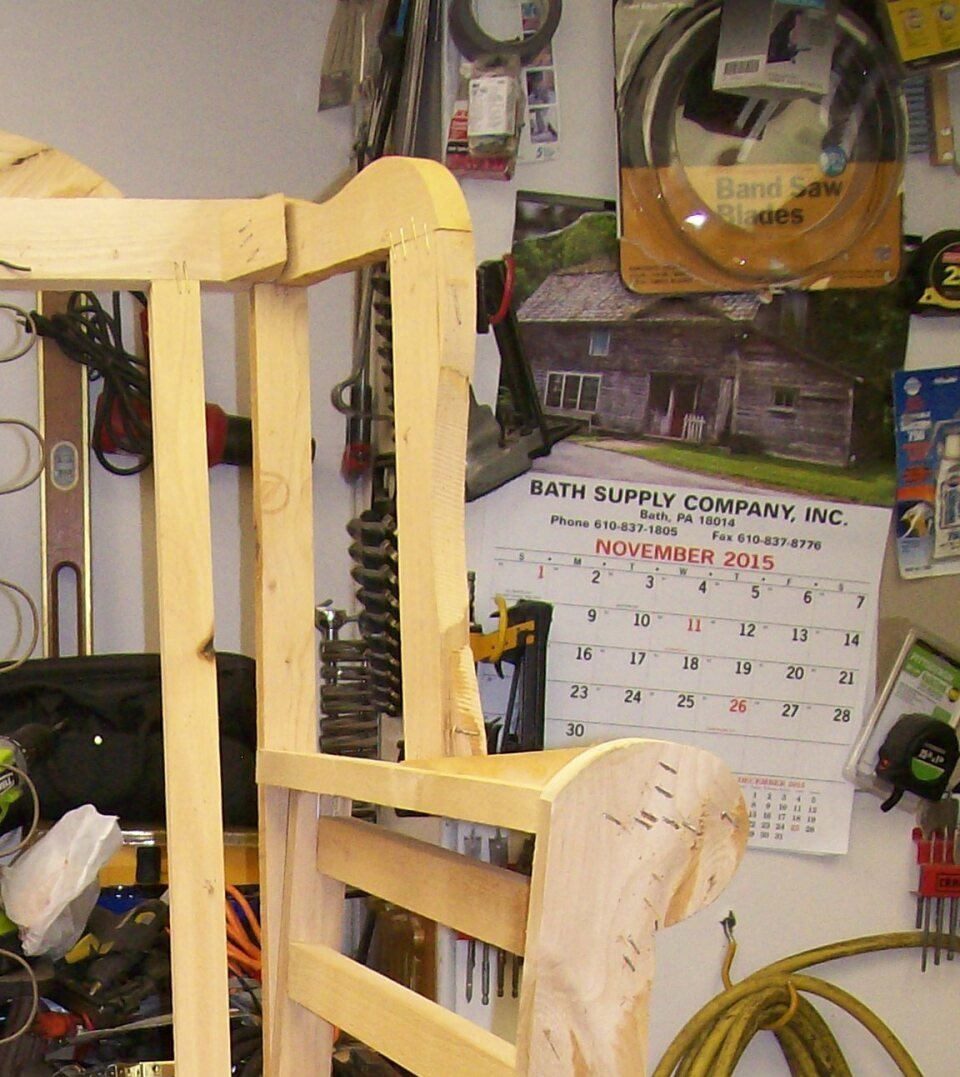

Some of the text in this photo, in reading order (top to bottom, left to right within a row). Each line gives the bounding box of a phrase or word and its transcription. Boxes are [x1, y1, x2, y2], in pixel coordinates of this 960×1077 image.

[716, 174, 843, 200] Band Saw
[716, 203, 805, 226] Blades
[530, 479, 848, 527] BATH SUPPLY COMPANY, INC.
[640, 509, 736, 528] Bath, PA 18014
[550, 515, 822, 551] Phone 610-837-1805 Fax 610-837-8776
[595, 538, 775, 571] NOVEMBER 2015
[538, 565, 865, 609] 1 2 3 4 5 6 7
[587, 608, 860, 647] 9 10 11 12 13 14
[576, 647, 854, 685] 16 17 18 19 20 21
[570, 685, 851, 722] 23 24 25 26 27 28
[565, 723, 585, 737] 30
